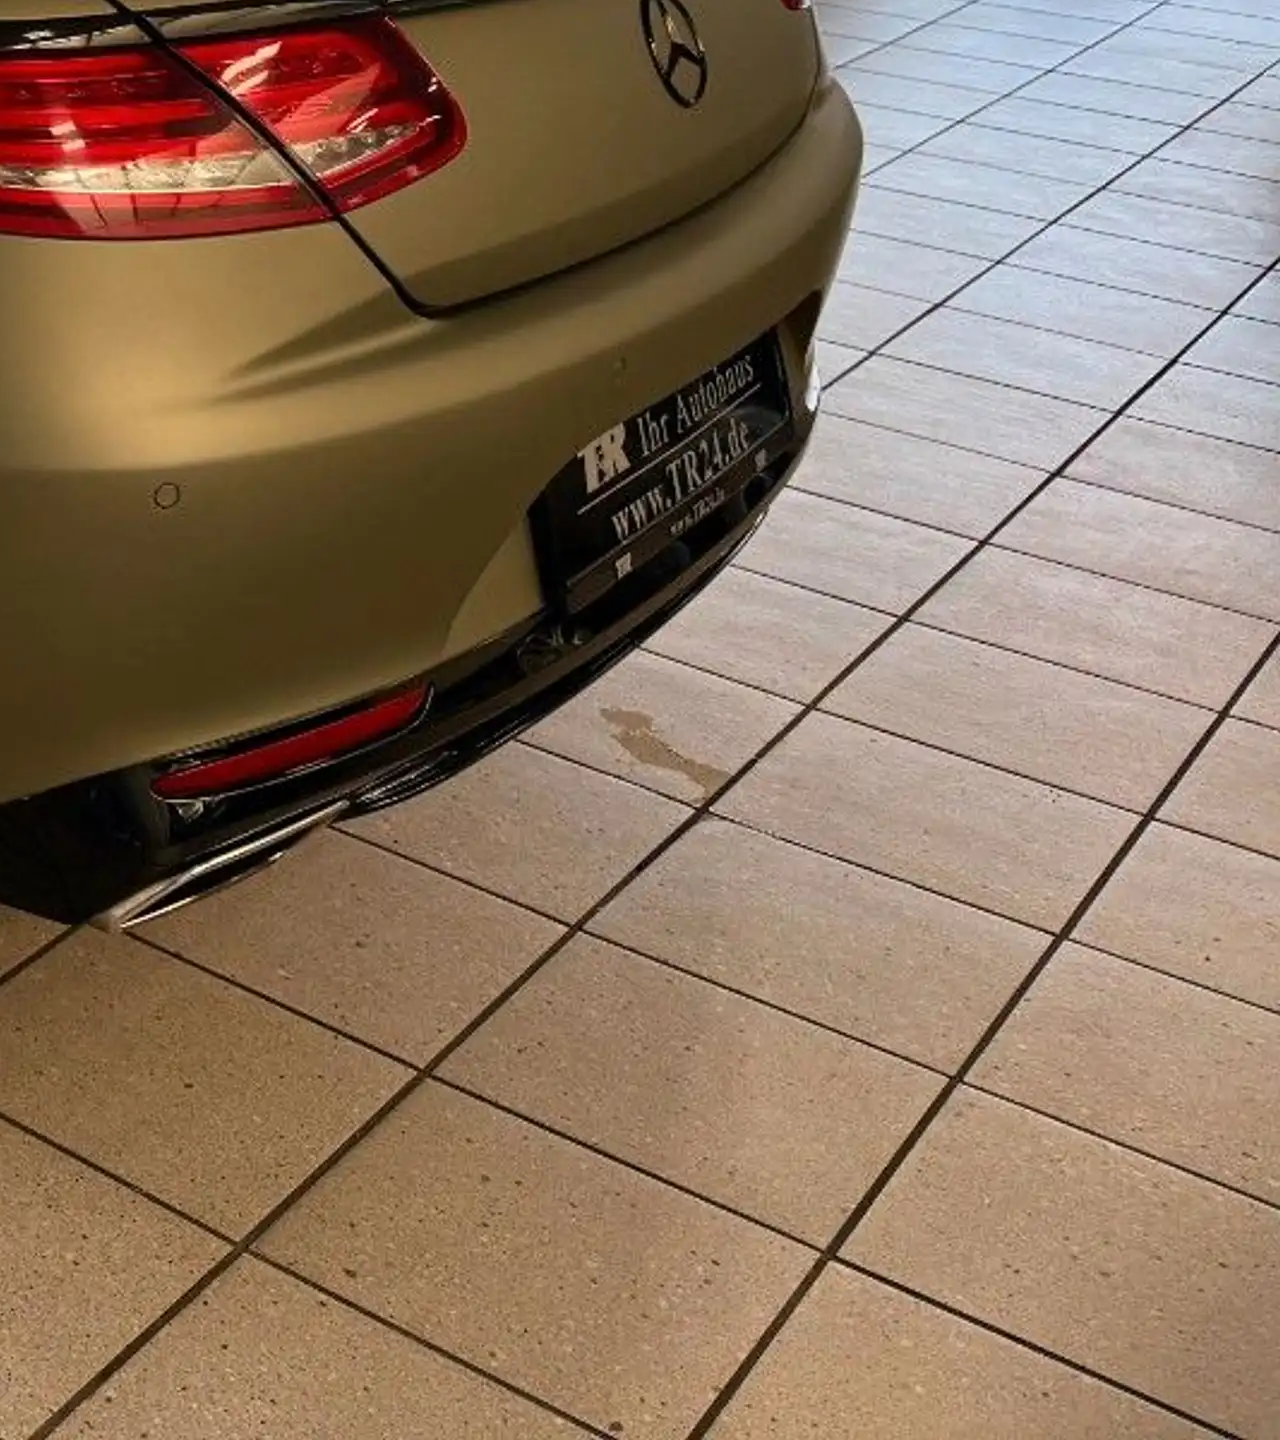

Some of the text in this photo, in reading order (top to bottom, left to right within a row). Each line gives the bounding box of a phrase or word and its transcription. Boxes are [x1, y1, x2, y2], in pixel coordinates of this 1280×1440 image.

[637, 355, 755, 457] Ihr Autohaus
[611, 418, 750, 544] www.TR24.de
